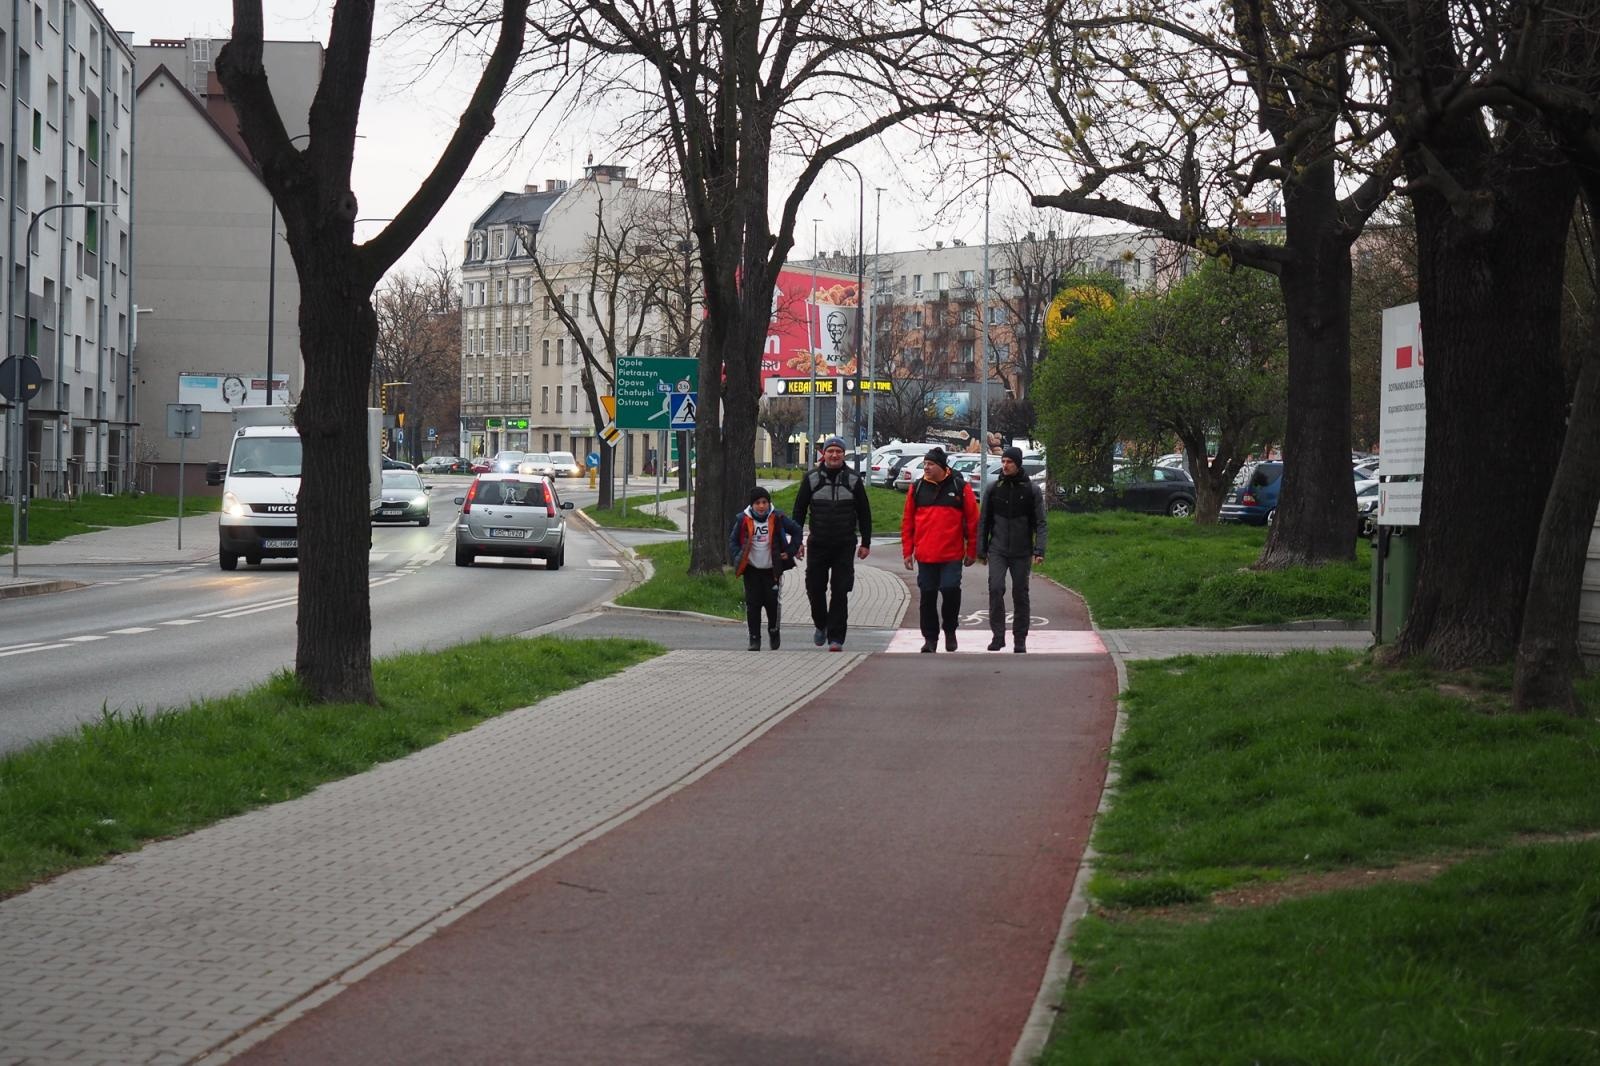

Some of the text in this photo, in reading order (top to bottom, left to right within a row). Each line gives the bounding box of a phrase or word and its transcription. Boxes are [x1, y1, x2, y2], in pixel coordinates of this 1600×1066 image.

[618, 358, 643, 367] Opole
[827, 354, 847, 362] KFC
[618, 368, 658, 378] Pietraszyn
[618, 378, 645, 387] Opava
[815, 381, 833, 392] TIME
[617, 398, 649, 406] Ostrava
